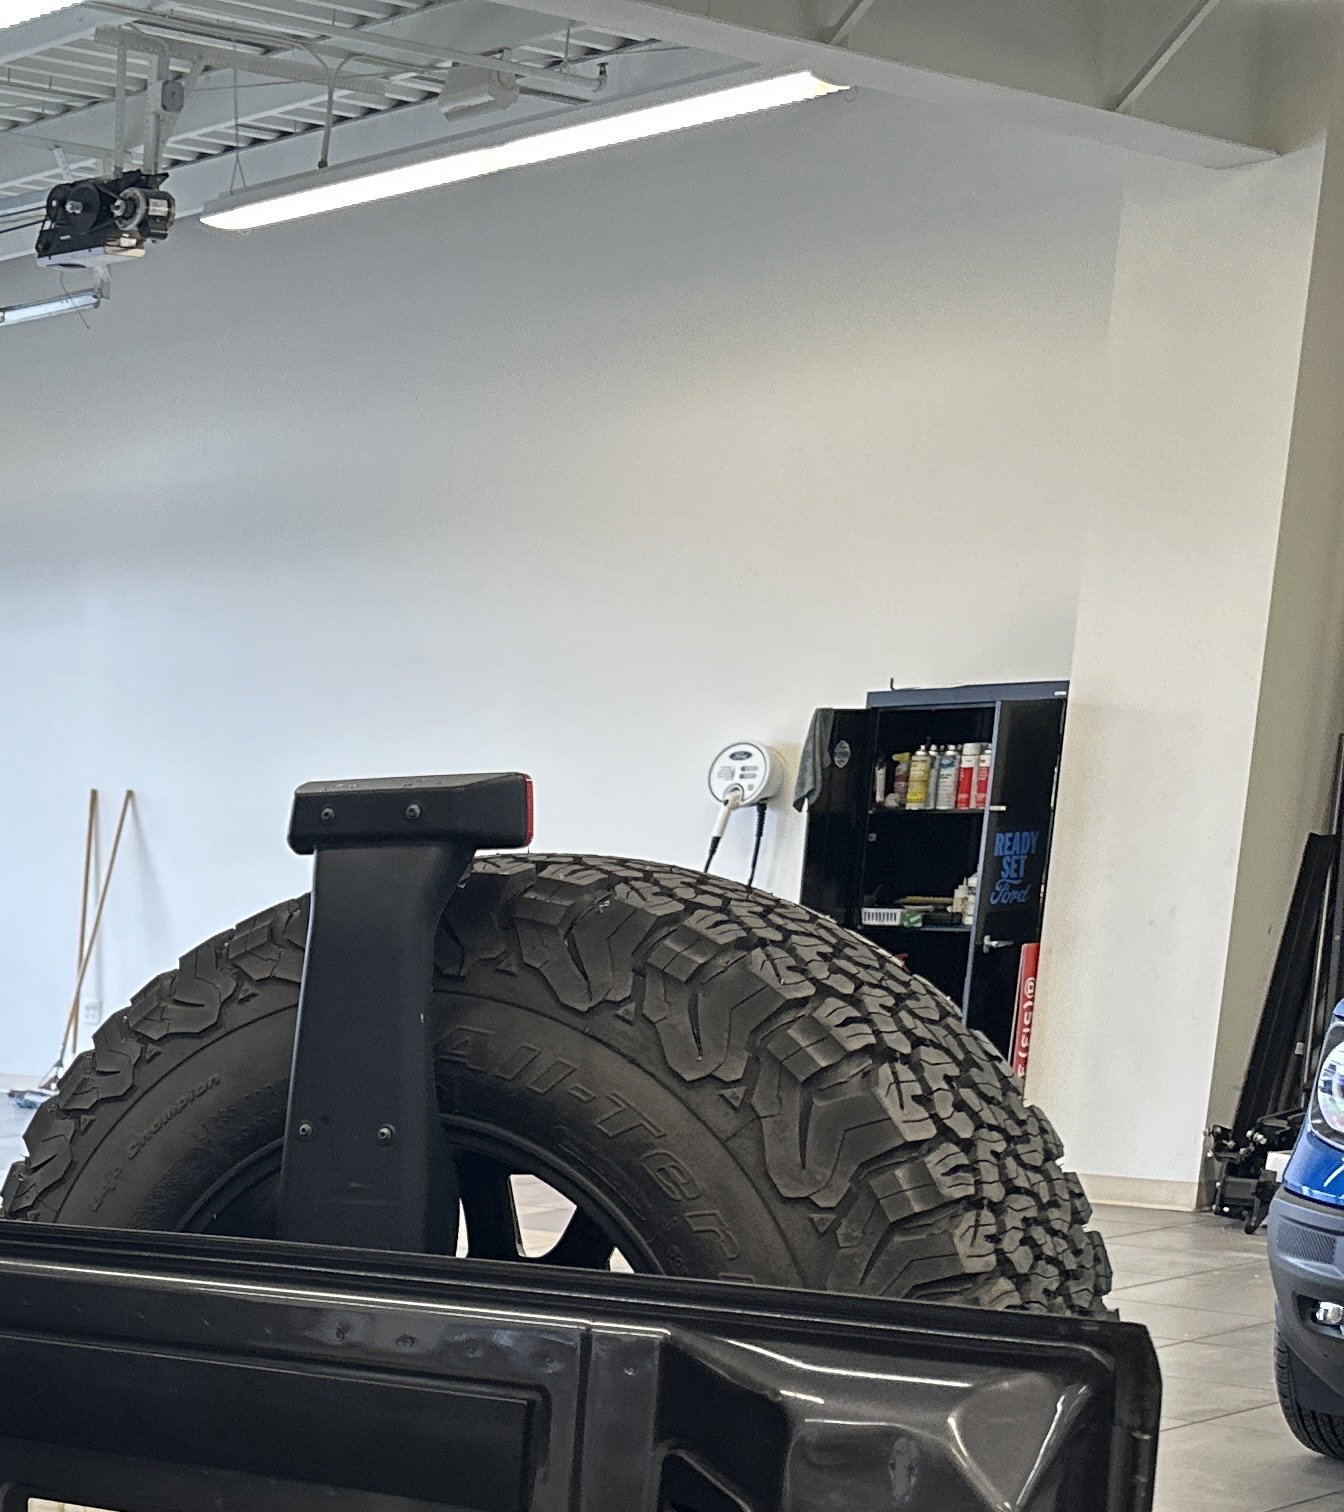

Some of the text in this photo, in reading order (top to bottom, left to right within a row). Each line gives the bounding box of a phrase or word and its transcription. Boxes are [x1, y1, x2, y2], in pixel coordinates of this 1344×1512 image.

[994, 831, 1039, 856] READY
[1000, 855, 1027, 879] SET
[990, 878, 1031, 905] Ford
